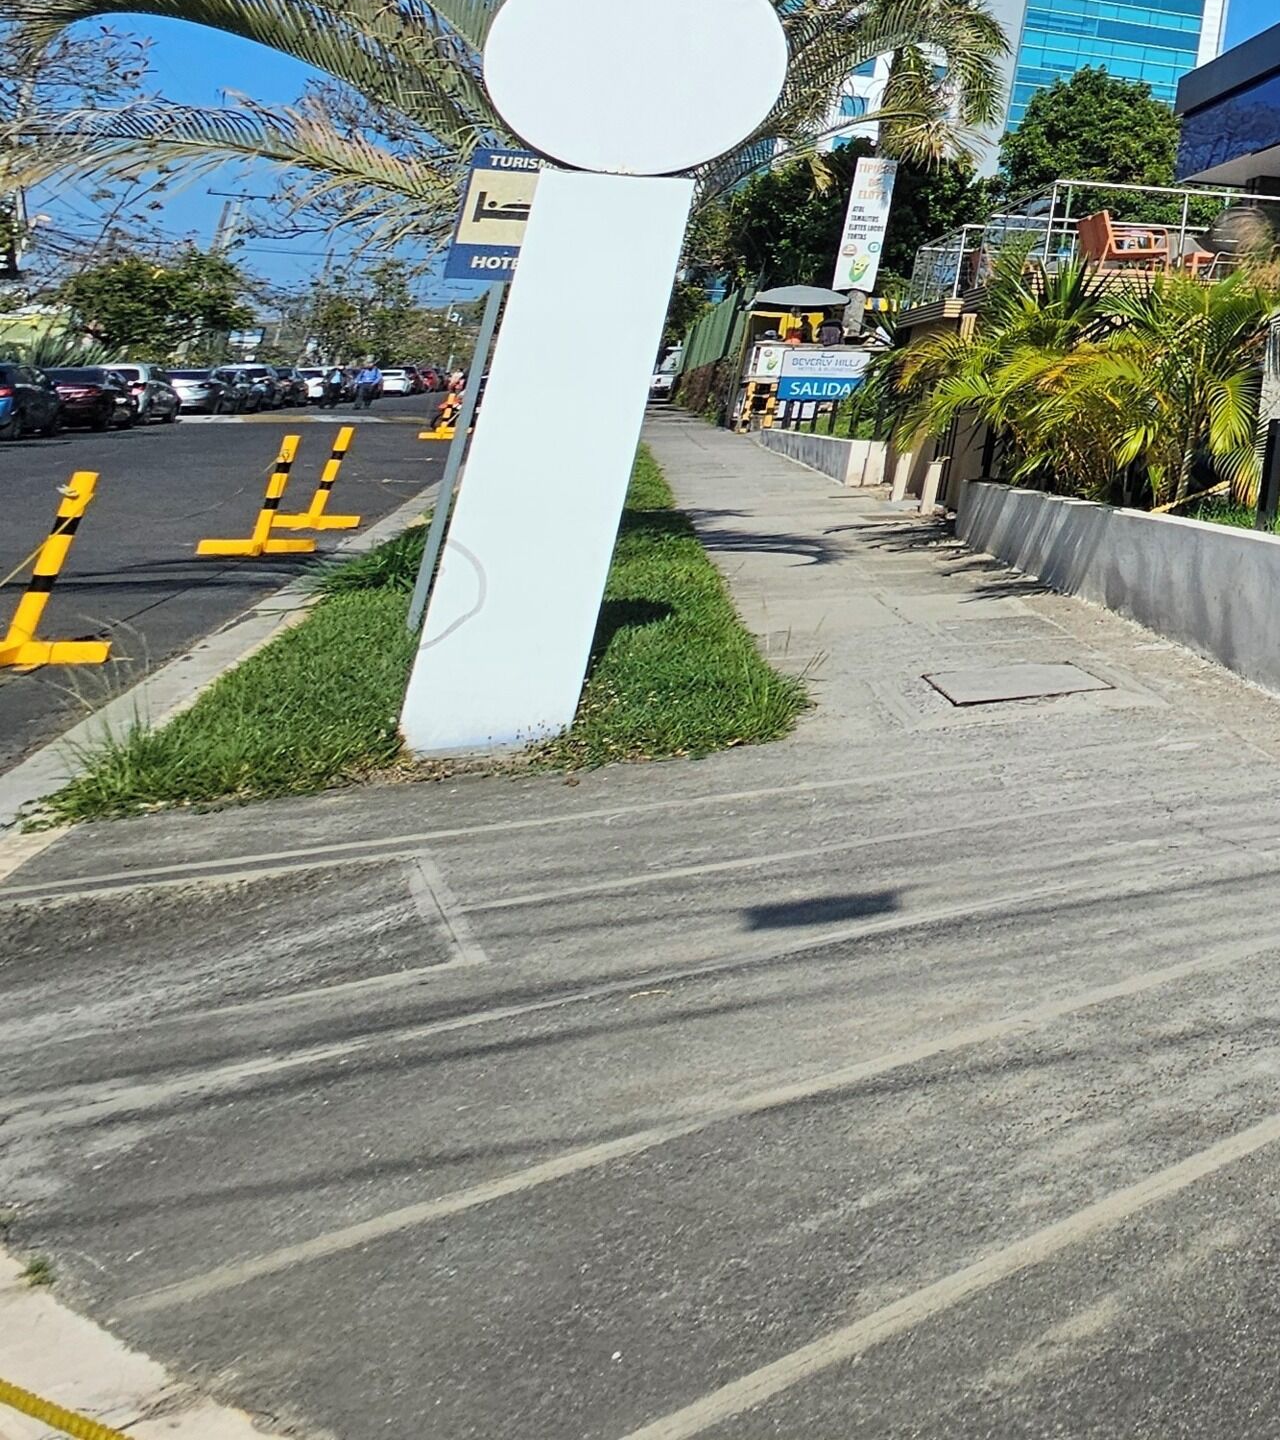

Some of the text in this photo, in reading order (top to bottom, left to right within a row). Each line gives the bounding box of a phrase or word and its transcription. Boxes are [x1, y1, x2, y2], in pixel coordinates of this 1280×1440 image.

[490, 155, 559, 169] TURISM
[470, 256, 520, 270] HOTE
[792, 357, 861, 367] BEVERLY HILLS
[789, 382, 852, 396] SALIDA
